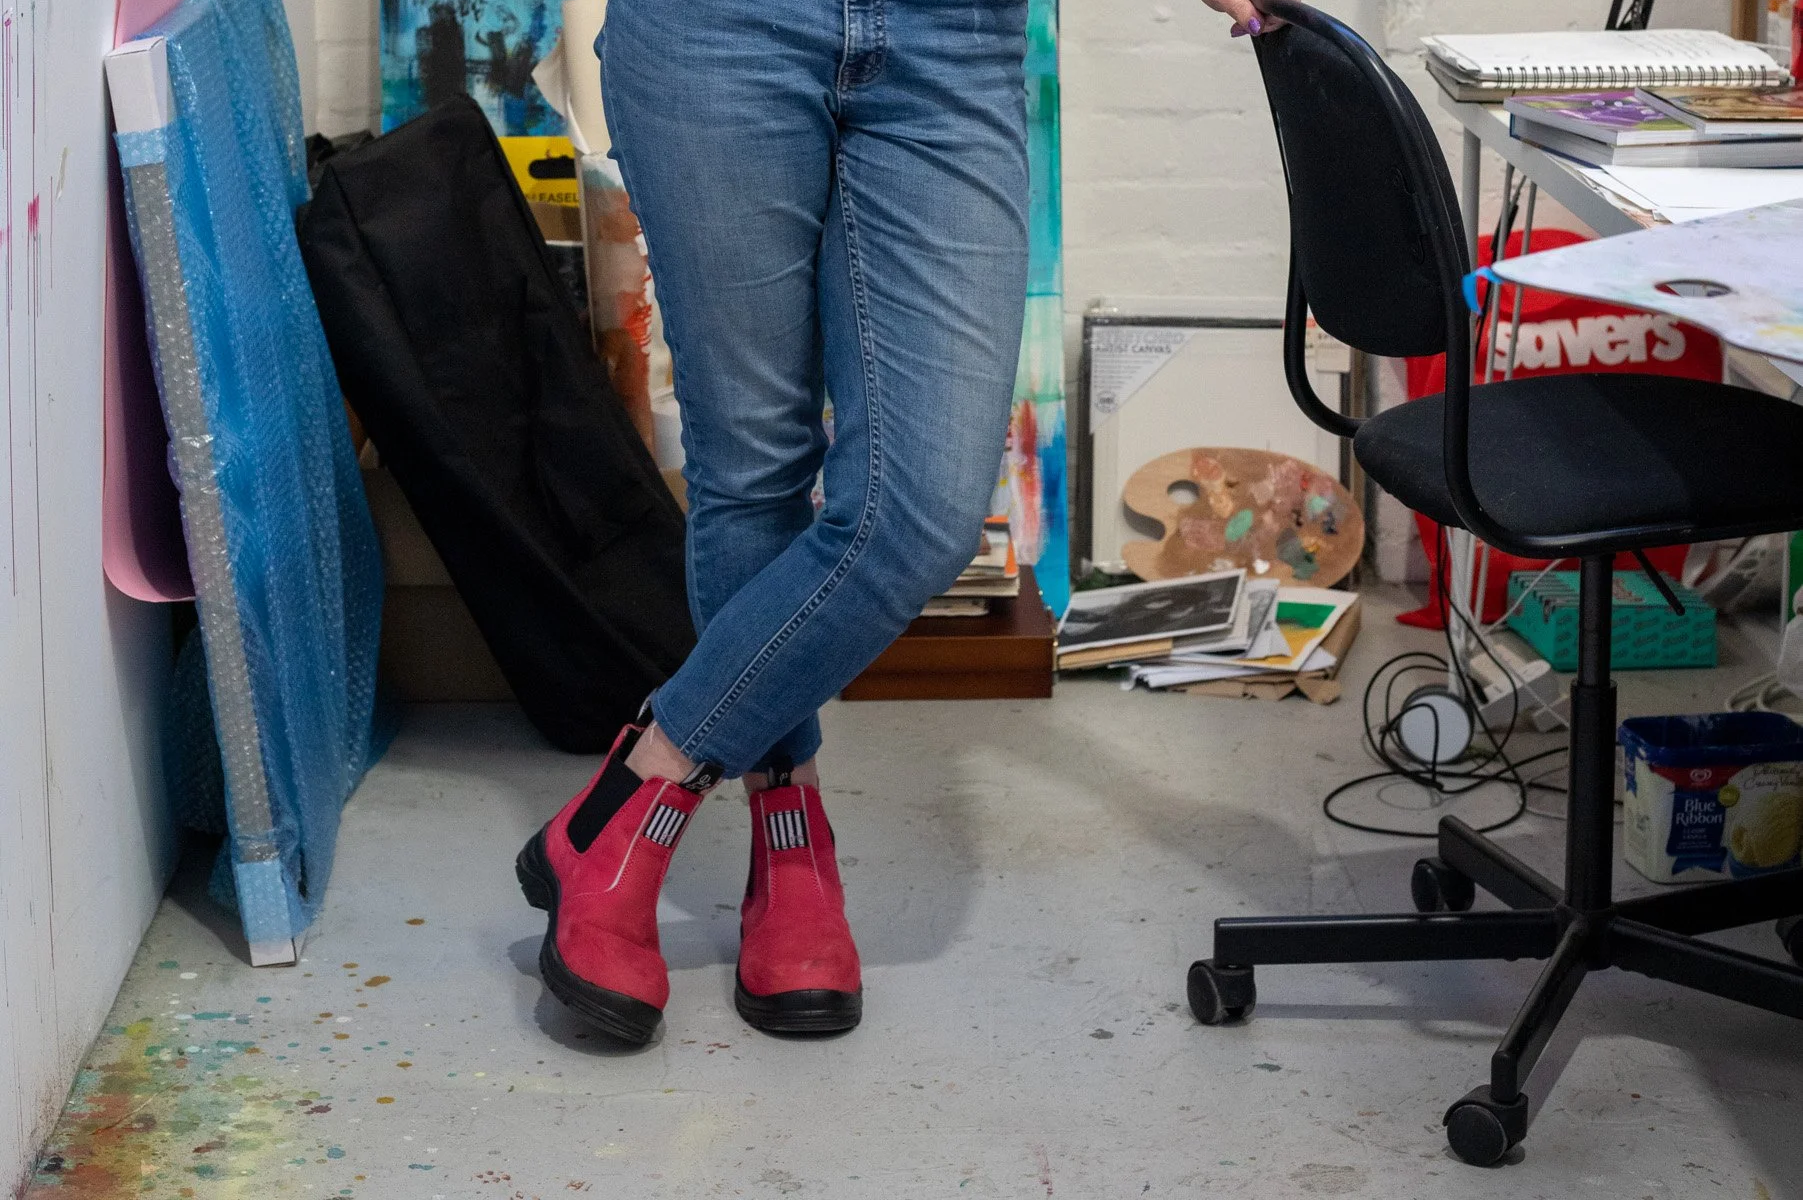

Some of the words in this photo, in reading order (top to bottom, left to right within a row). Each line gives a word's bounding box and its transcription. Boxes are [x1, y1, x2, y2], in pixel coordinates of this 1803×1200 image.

[1131, 344, 1172, 354] CANVAS
[1488, 314, 1687, 371] savers
[1684, 799, 1717, 813] Blue
[1675, 812, 1723, 826] Ribbon
